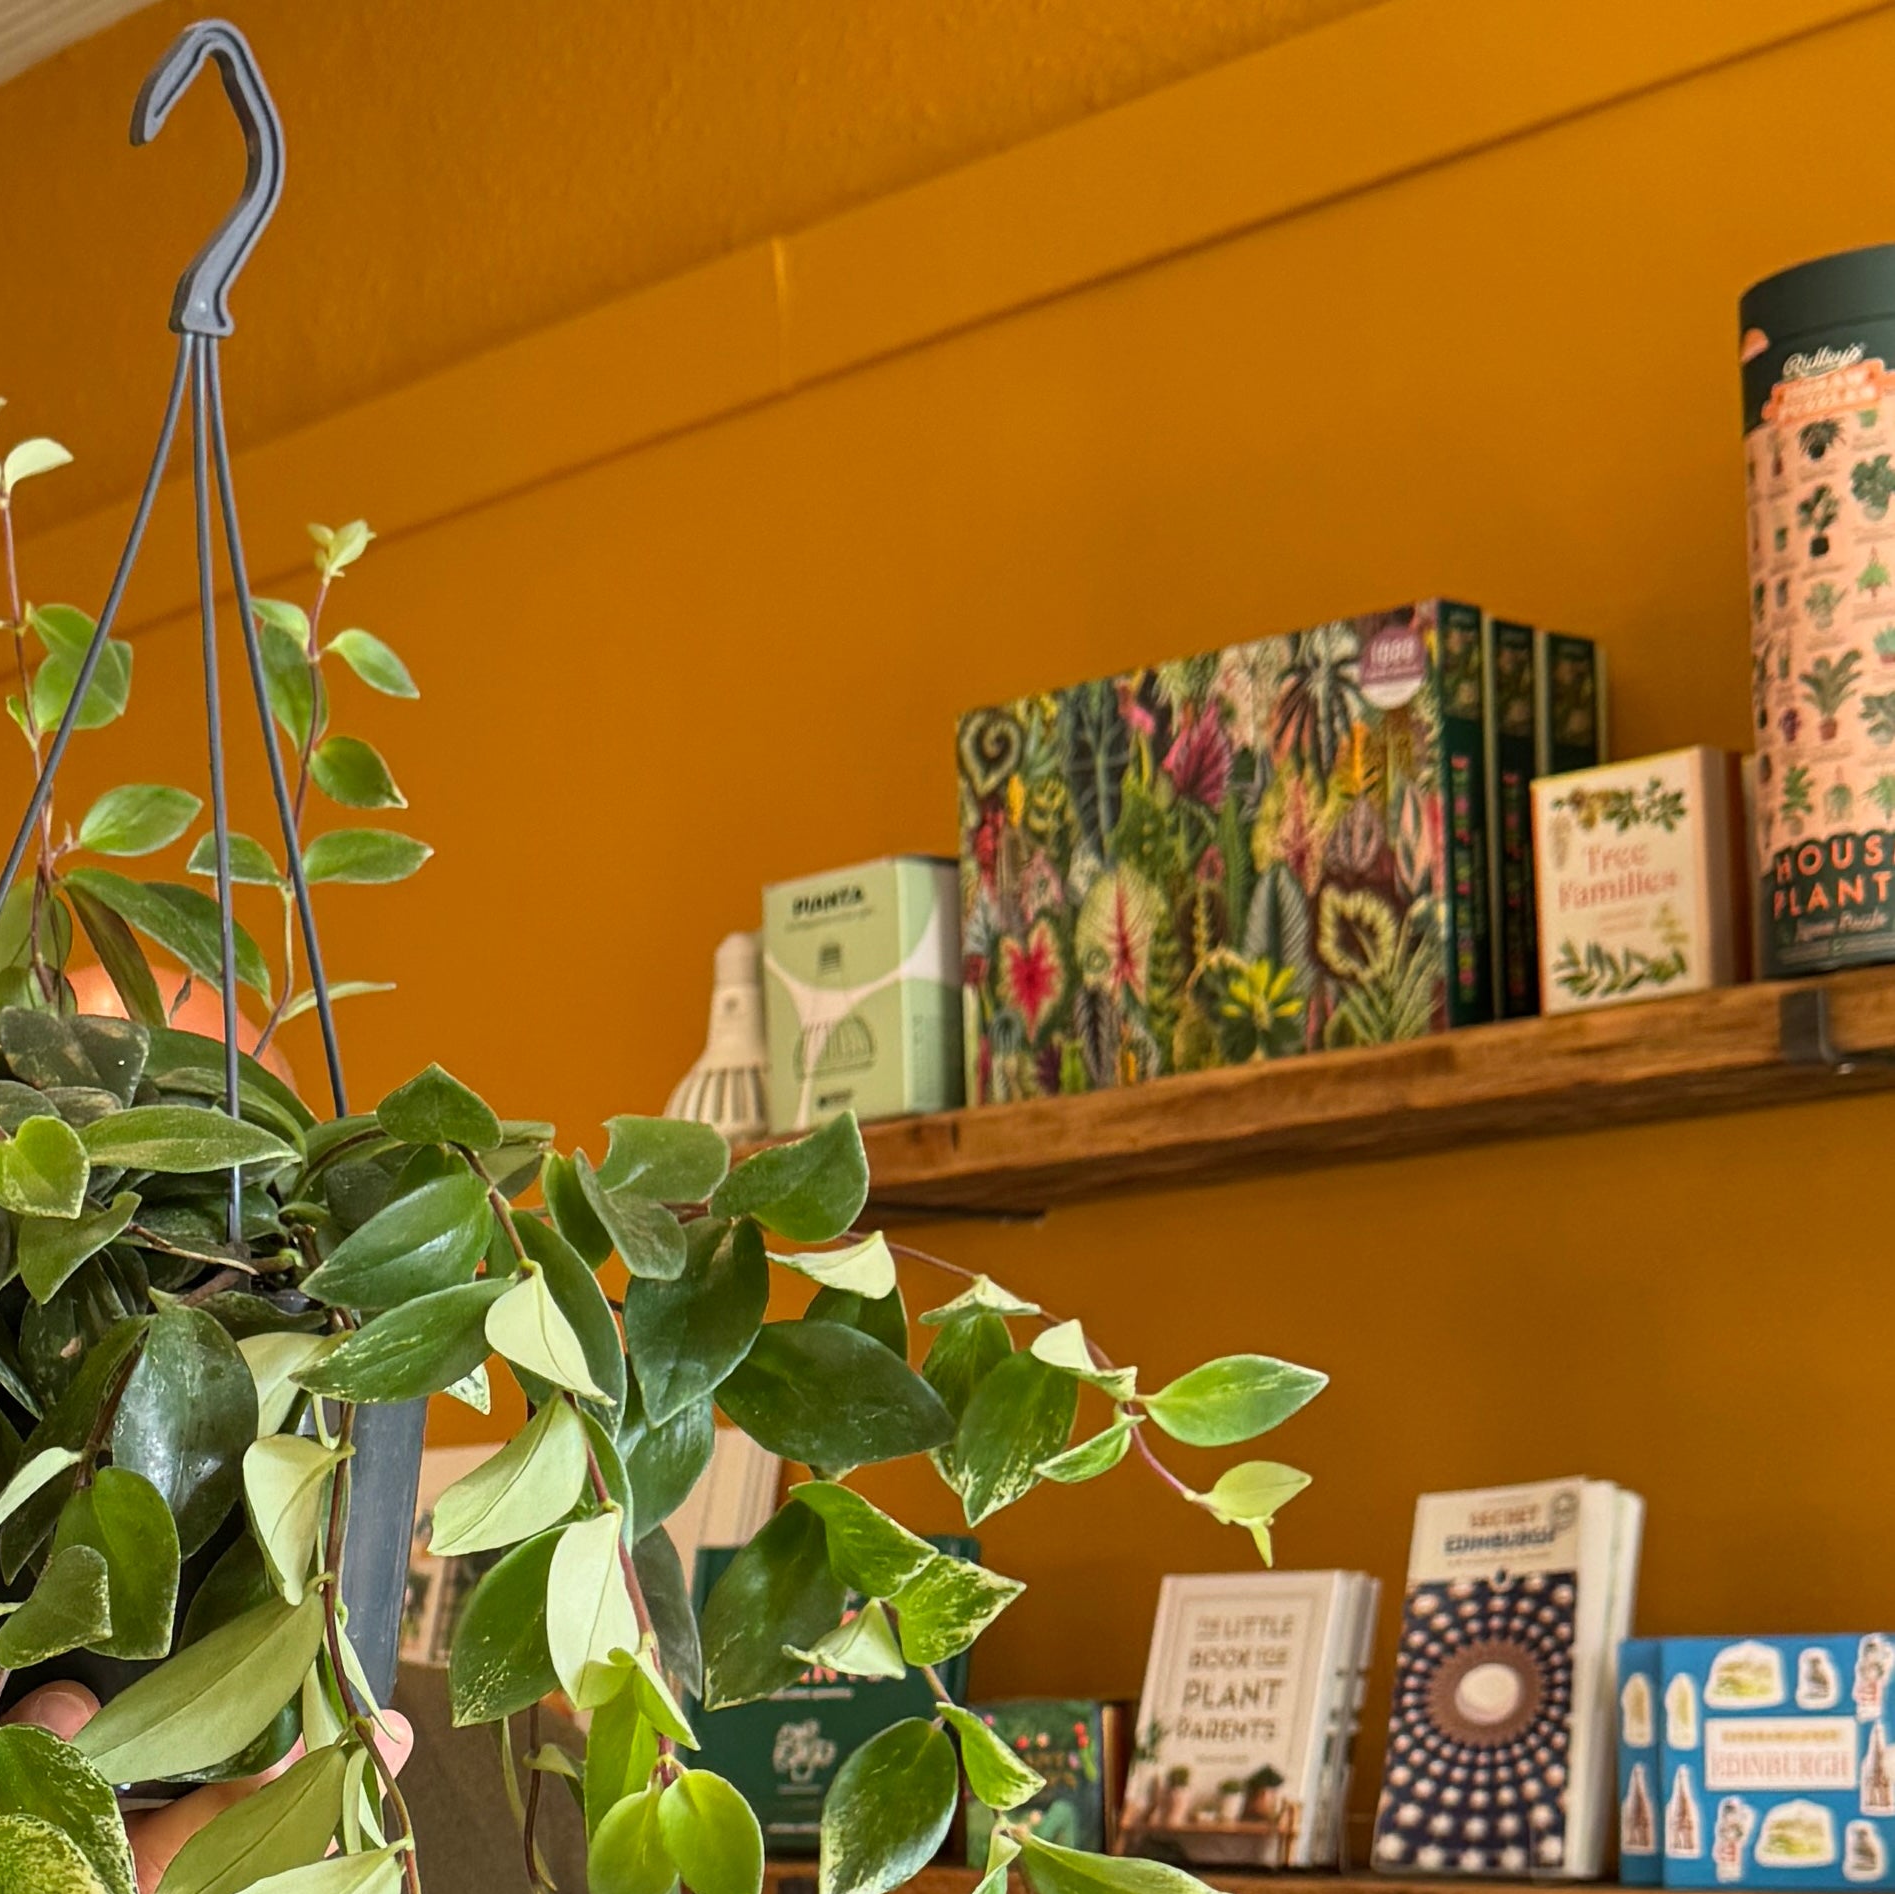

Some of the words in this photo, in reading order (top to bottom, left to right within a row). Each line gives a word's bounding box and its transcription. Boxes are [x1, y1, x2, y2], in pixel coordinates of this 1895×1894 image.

[1583, 845, 1648, 876] Tree
[1776, 834, 1895, 884] HOUS
[1559, 869, 1677, 912] Families
[1223, 1613, 1294, 1640] LITTLE
[1188, 1649, 1250, 1672] BOOK
[1182, 1677, 1283, 1710] PLANT
[1177, 1717, 1276, 1742] PARENTS
[1710, 1751, 1849, 1778] EDINBURGH
